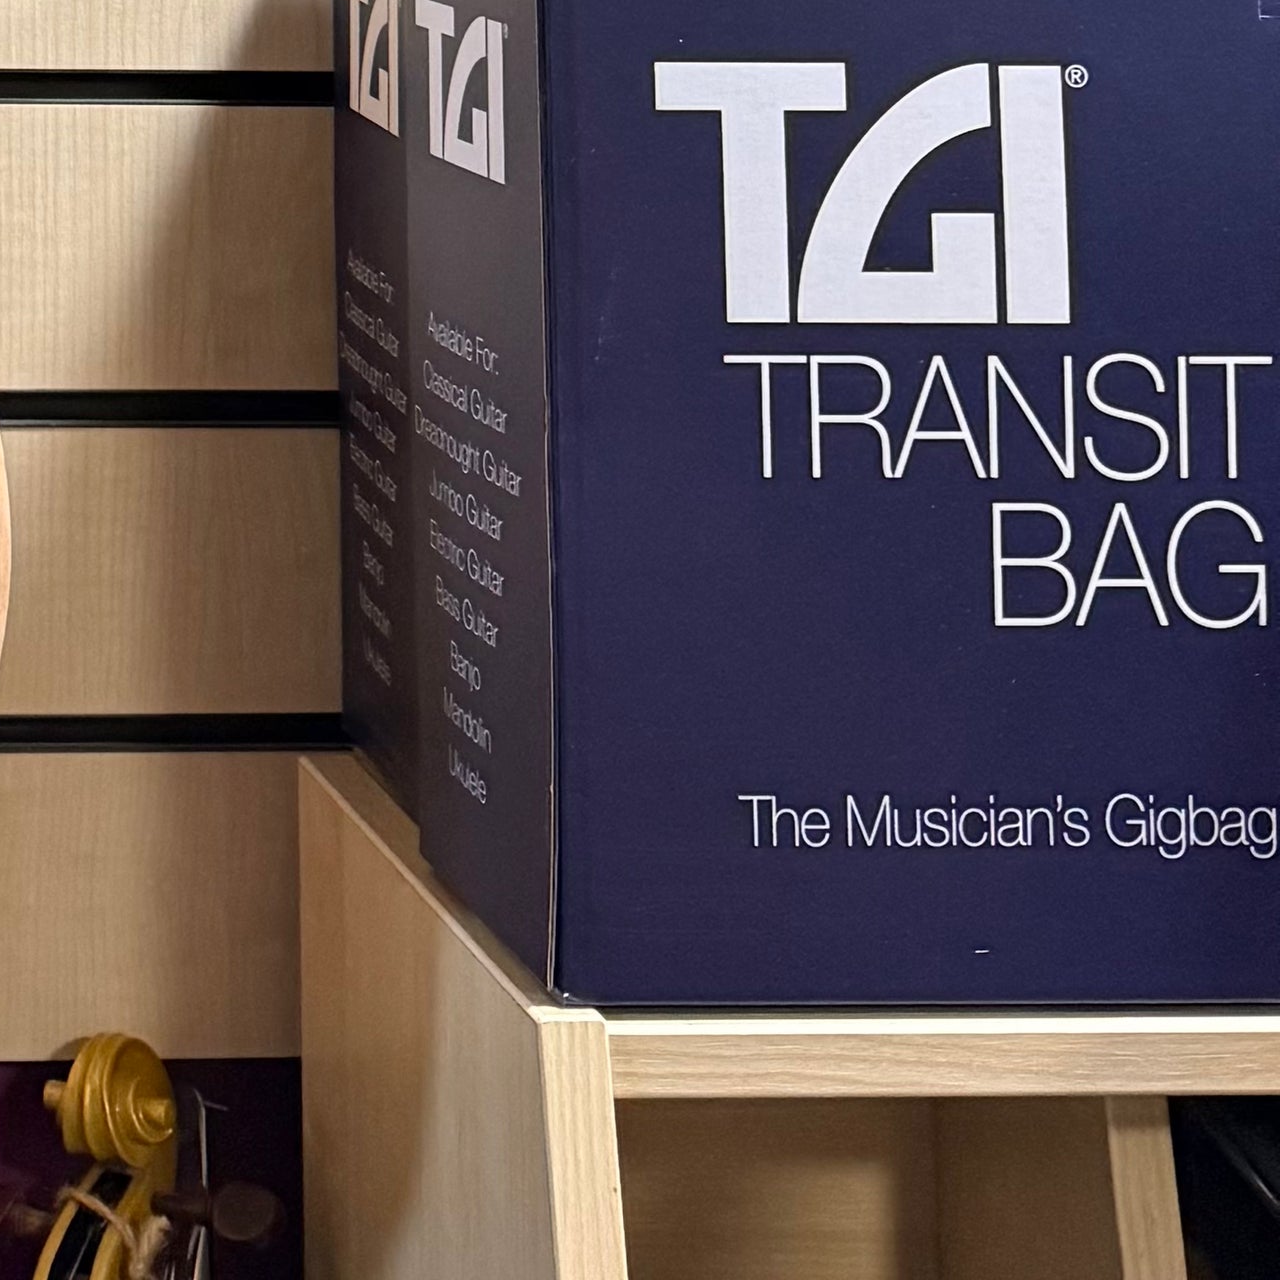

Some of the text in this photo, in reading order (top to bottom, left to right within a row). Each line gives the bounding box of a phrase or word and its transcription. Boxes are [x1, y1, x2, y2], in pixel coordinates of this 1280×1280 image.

[428, 311, 473, 362] Available
[423, 359, 508, 434] Classical Guitar
[723, 352, 1274, 482] TRANSIT
[429, 467, 503, 541] Jumbo Guitar
[482, 449, 522, 497] Guitar
[430, 518, 505, 597] Electric Guitar
[992, 499, 1268, 629] BAG
[436, 575, 461, 622] Bass
[462, 598, 499, 648] Guitar
[450, 640, 481, 691] Banjo
[443, 685, 492, 754] Mandolin
[448, 743, 487, 804] Ukulele
[738, 792, 1279, 860] The Musician's Gigbag
